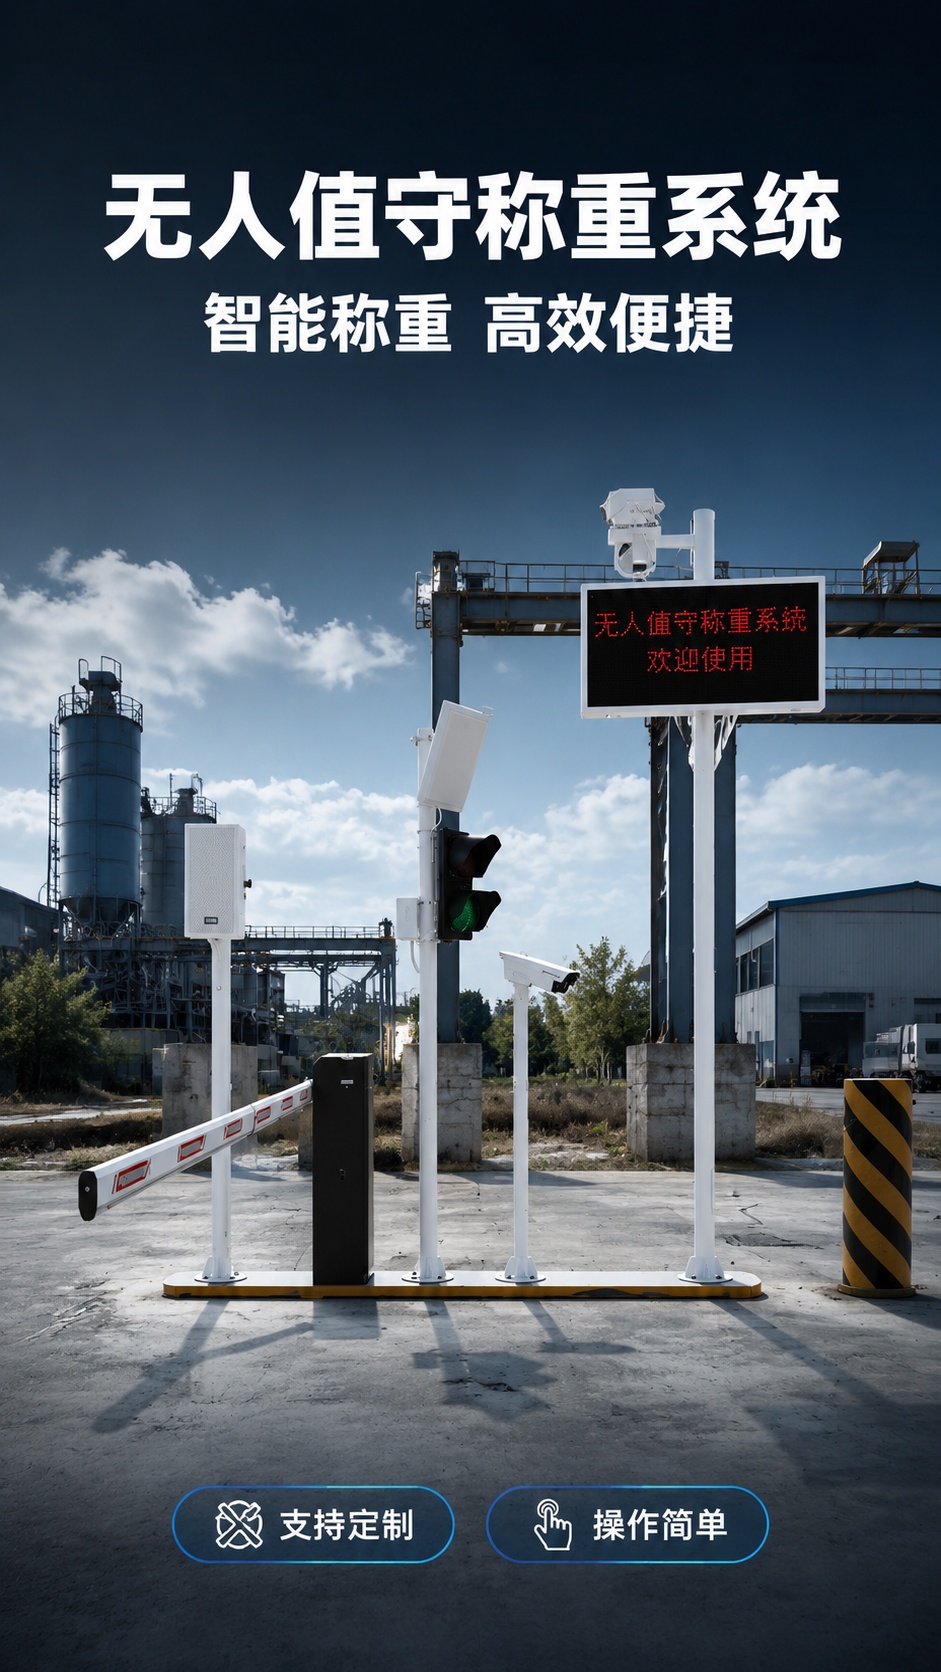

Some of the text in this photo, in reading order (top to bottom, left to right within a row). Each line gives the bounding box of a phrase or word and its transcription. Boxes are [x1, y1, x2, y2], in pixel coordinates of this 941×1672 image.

[594, 606, 807, 637] 无人值守称重系统
[647, 646, 753, 673] 欢迎使用
